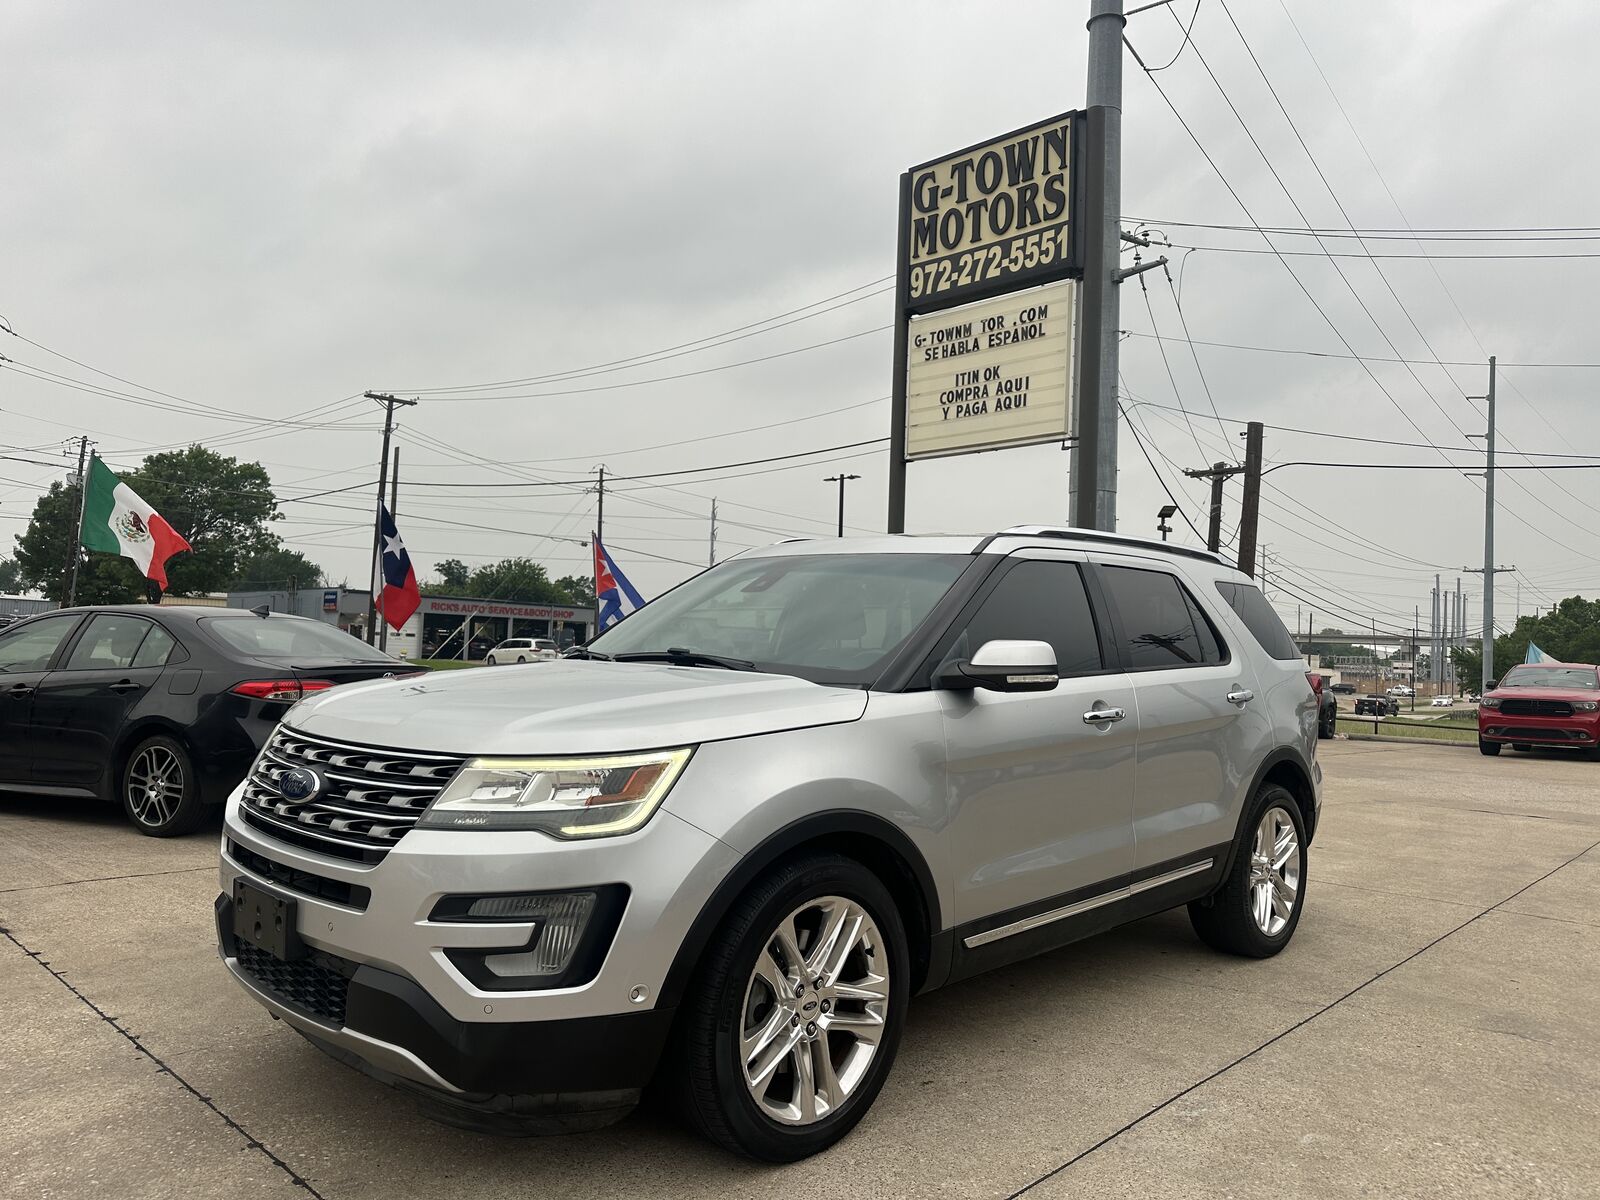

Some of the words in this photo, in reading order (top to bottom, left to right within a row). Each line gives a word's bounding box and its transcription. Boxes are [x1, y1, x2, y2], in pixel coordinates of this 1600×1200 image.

[913, 125, 1069, 213] G-TOWN
[912, 173, 1066, 259] MOTORS
[910, 225, 1069, 298] 972-272-5551
[988, 323, 1046, 348] ESPANOL
[955, 369, 979, 387] ITIN
[984, 365, 1000, 382] OK
[939, 384, 989, 405] COMPRA
[996, 376, 1030, 396] AQUI
[942, 406, 950, 420] Y
[956, 400, 987, 418] PAGA
[995, 393, 1027, 412] AQUI
[553, 610, 574, 619] SHOP
